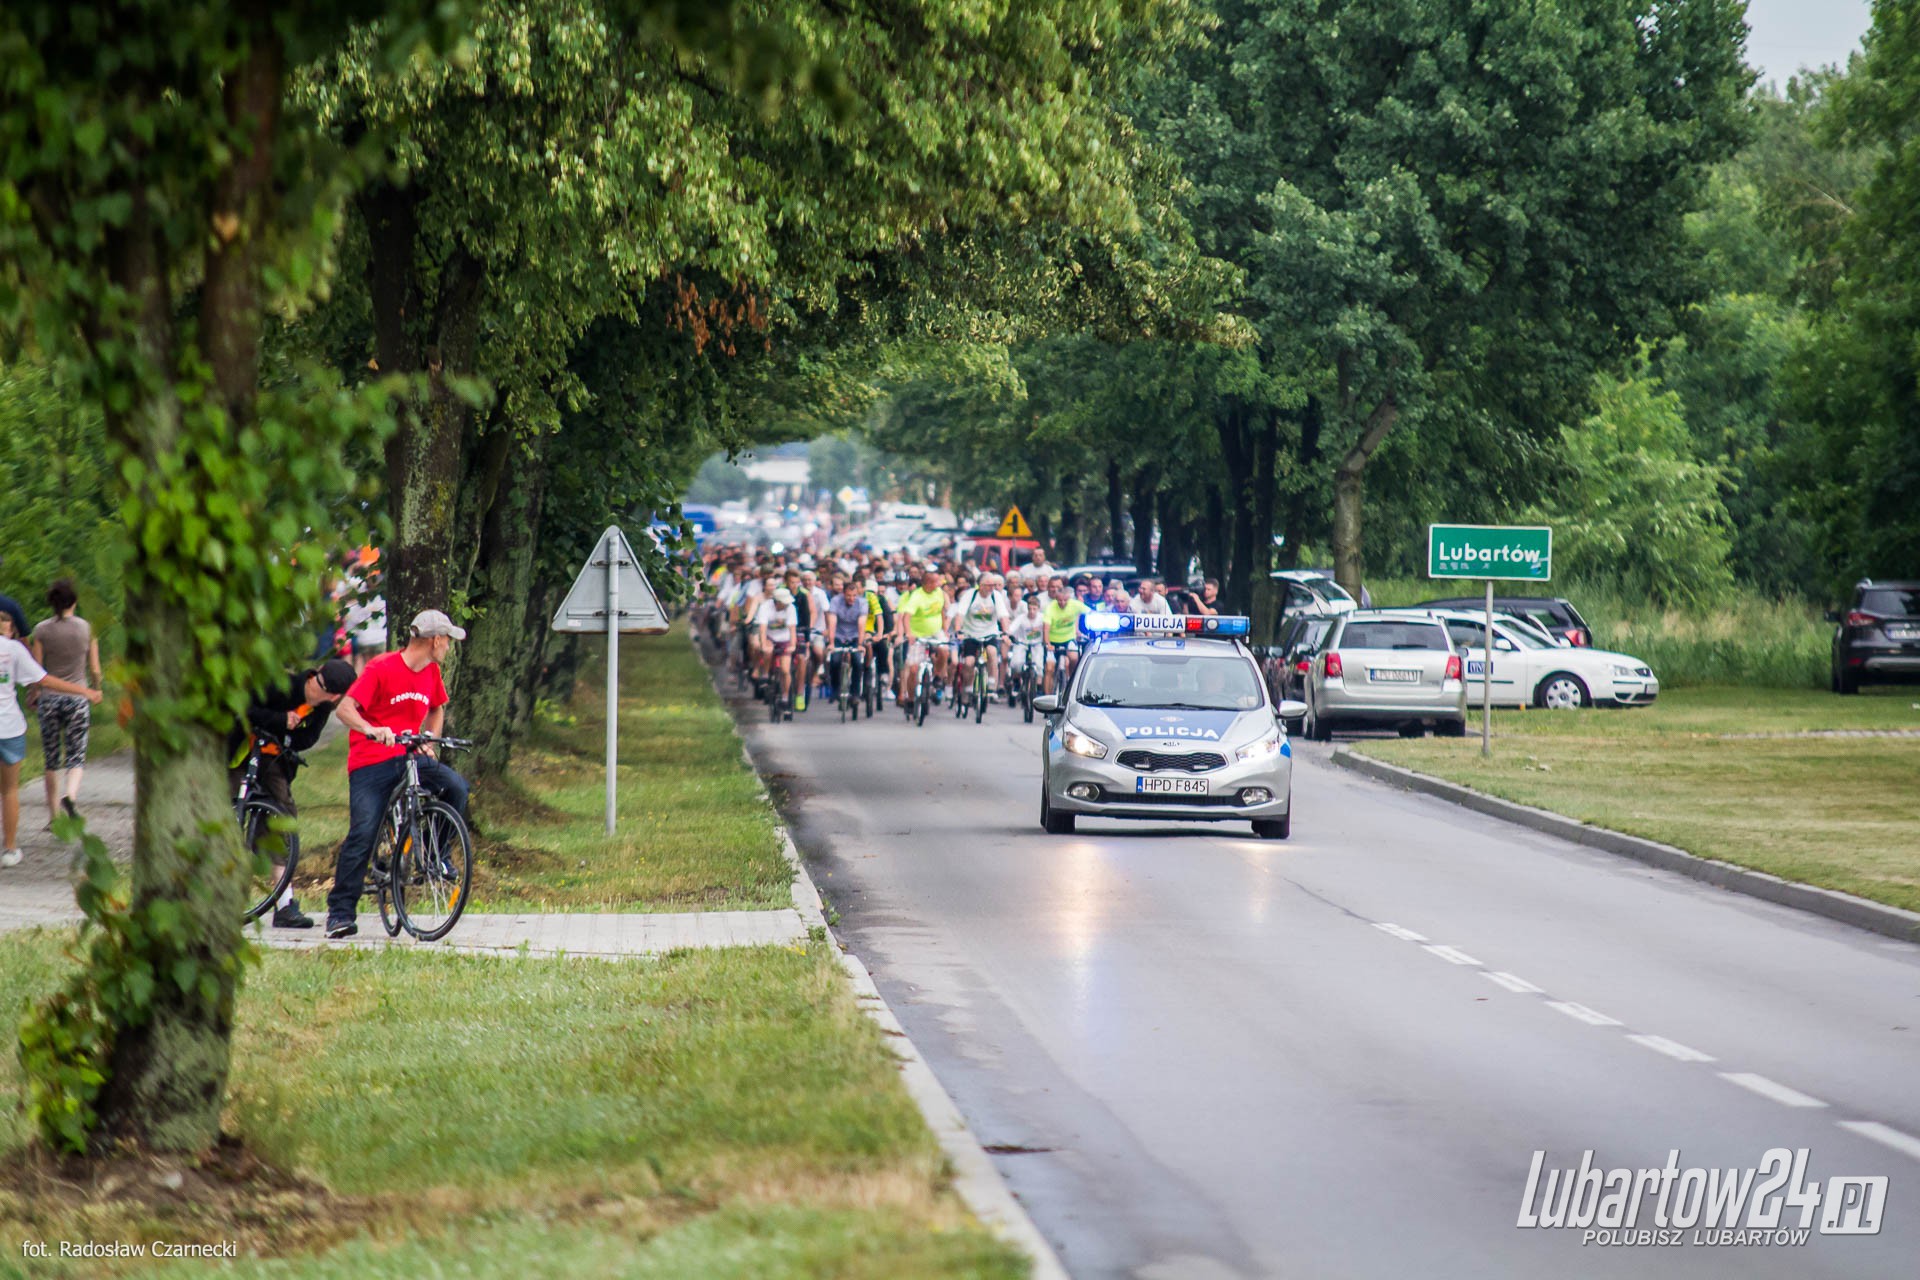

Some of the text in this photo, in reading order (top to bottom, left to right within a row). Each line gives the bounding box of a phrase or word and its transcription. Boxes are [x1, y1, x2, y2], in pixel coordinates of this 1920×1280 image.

[1439, 542, 1540, 563] Lubartów
[1136, 617, 1183, 629] POLICJA
[1125, 726, 1219, 739] POLICJA
[1144, 778, 1206, 793] HPD F845
